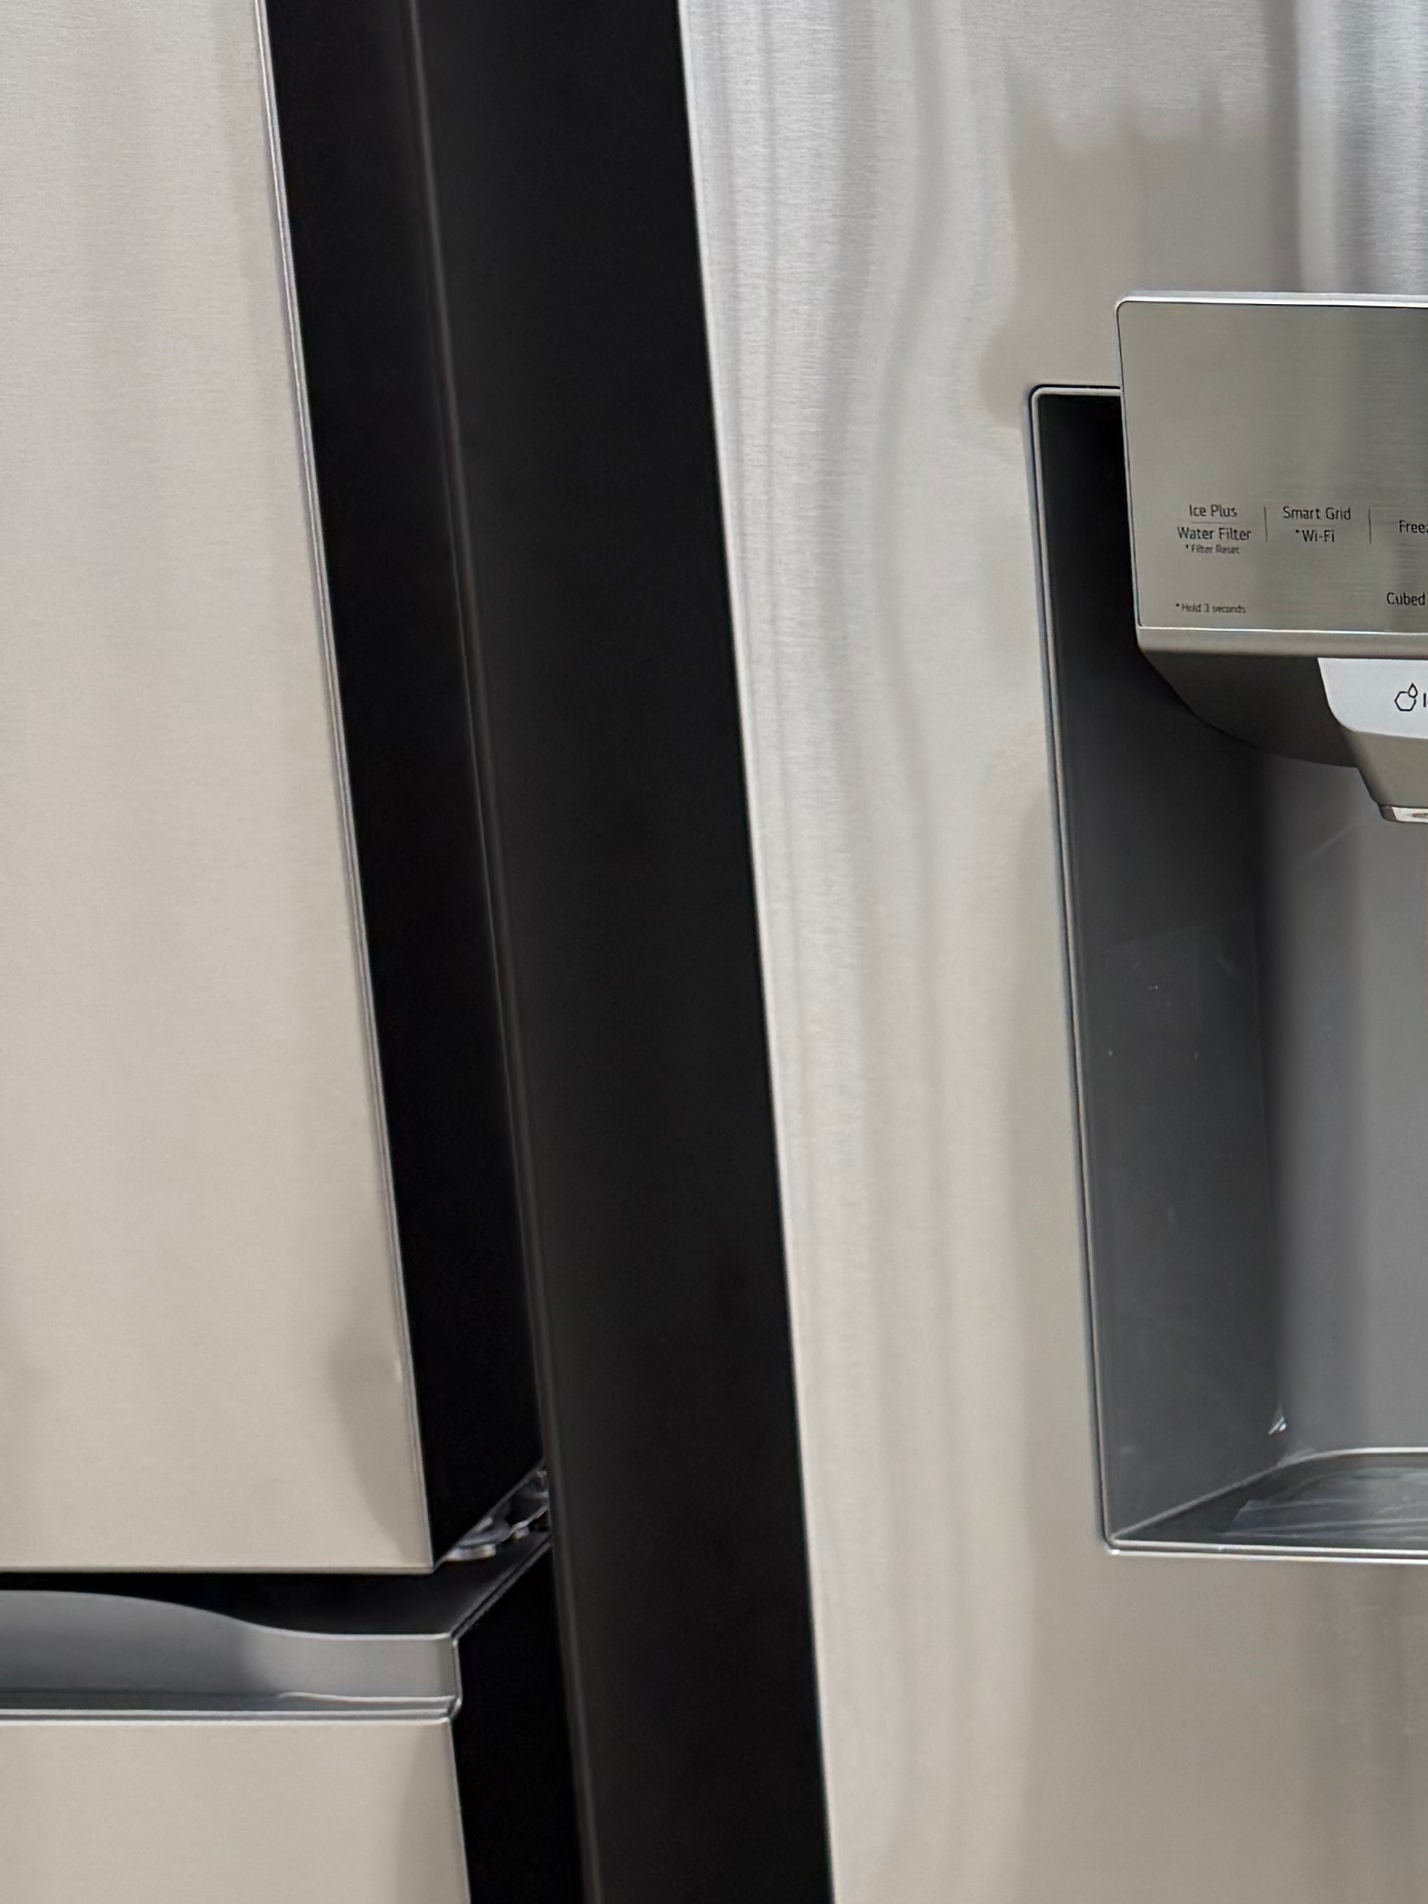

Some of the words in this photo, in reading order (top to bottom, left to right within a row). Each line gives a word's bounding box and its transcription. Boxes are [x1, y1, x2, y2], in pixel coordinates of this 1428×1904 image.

[1189, 504, 1207, 518] Ice
[1211, 504, 1238, 518] Plus
[1283, 506, 1321, 520] Smart
[1325, 506, 1352, 520] Grid
[1177, 526, 1214, 540] Water
[1218, 527, 1252, 541] Filter
[1302, 529, 1335, 543] Wi-Fi
[1191, 544, 1213, 554] Filter
[1216, 545, 1240, 555] Reset
[1386, 592, 1426, 606] Cubed
[1182, 604, 1202, 613] Hold
[1212, 604, 1246, 614] seconds
